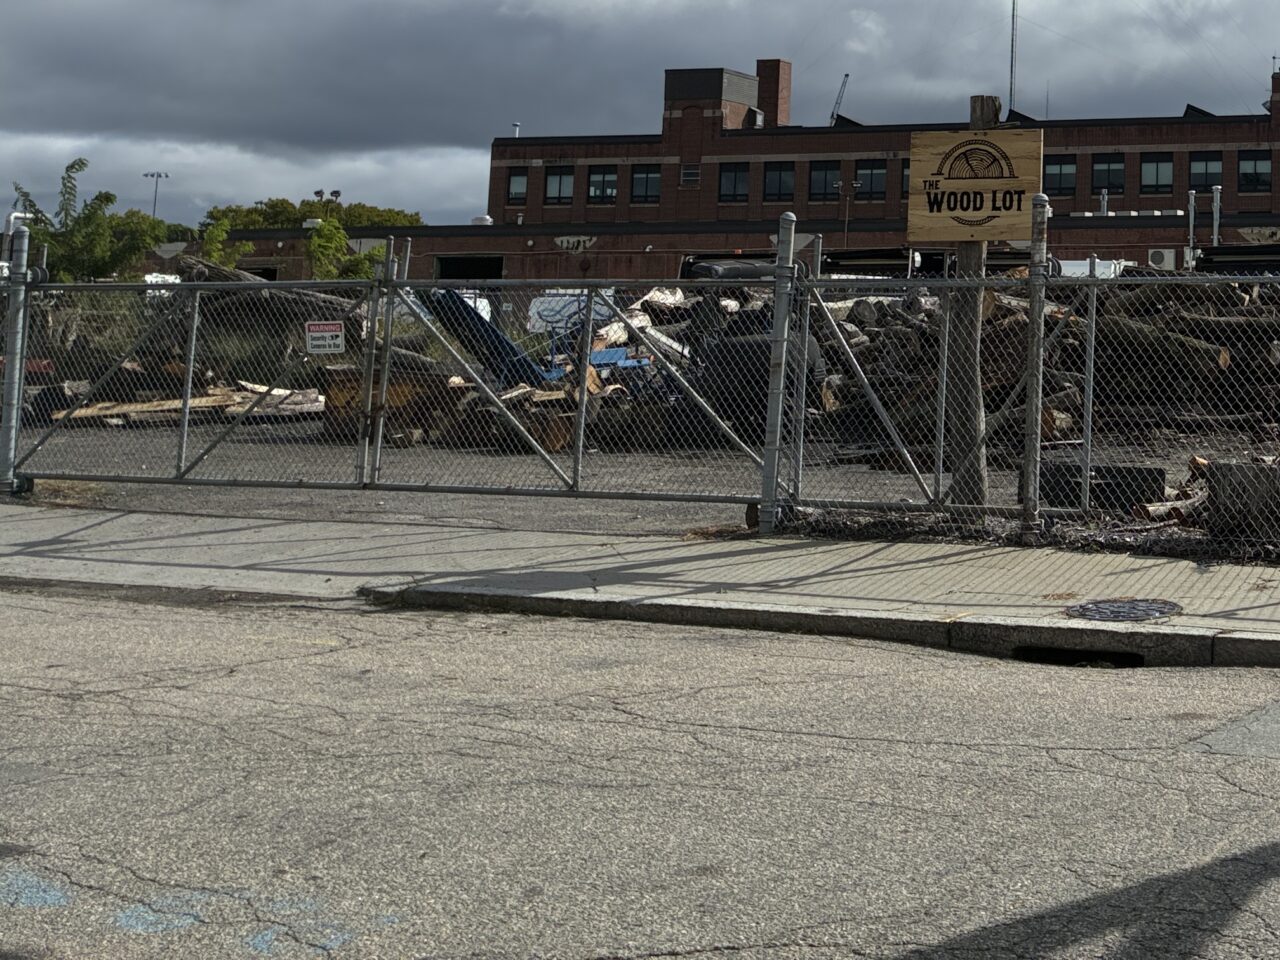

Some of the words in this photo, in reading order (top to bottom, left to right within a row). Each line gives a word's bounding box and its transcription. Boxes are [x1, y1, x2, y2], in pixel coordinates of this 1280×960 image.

[922, 180, 940, 190] THE
[926, 190, 985, 213] WOOD
[991, 189, 1025, 212] LOT
